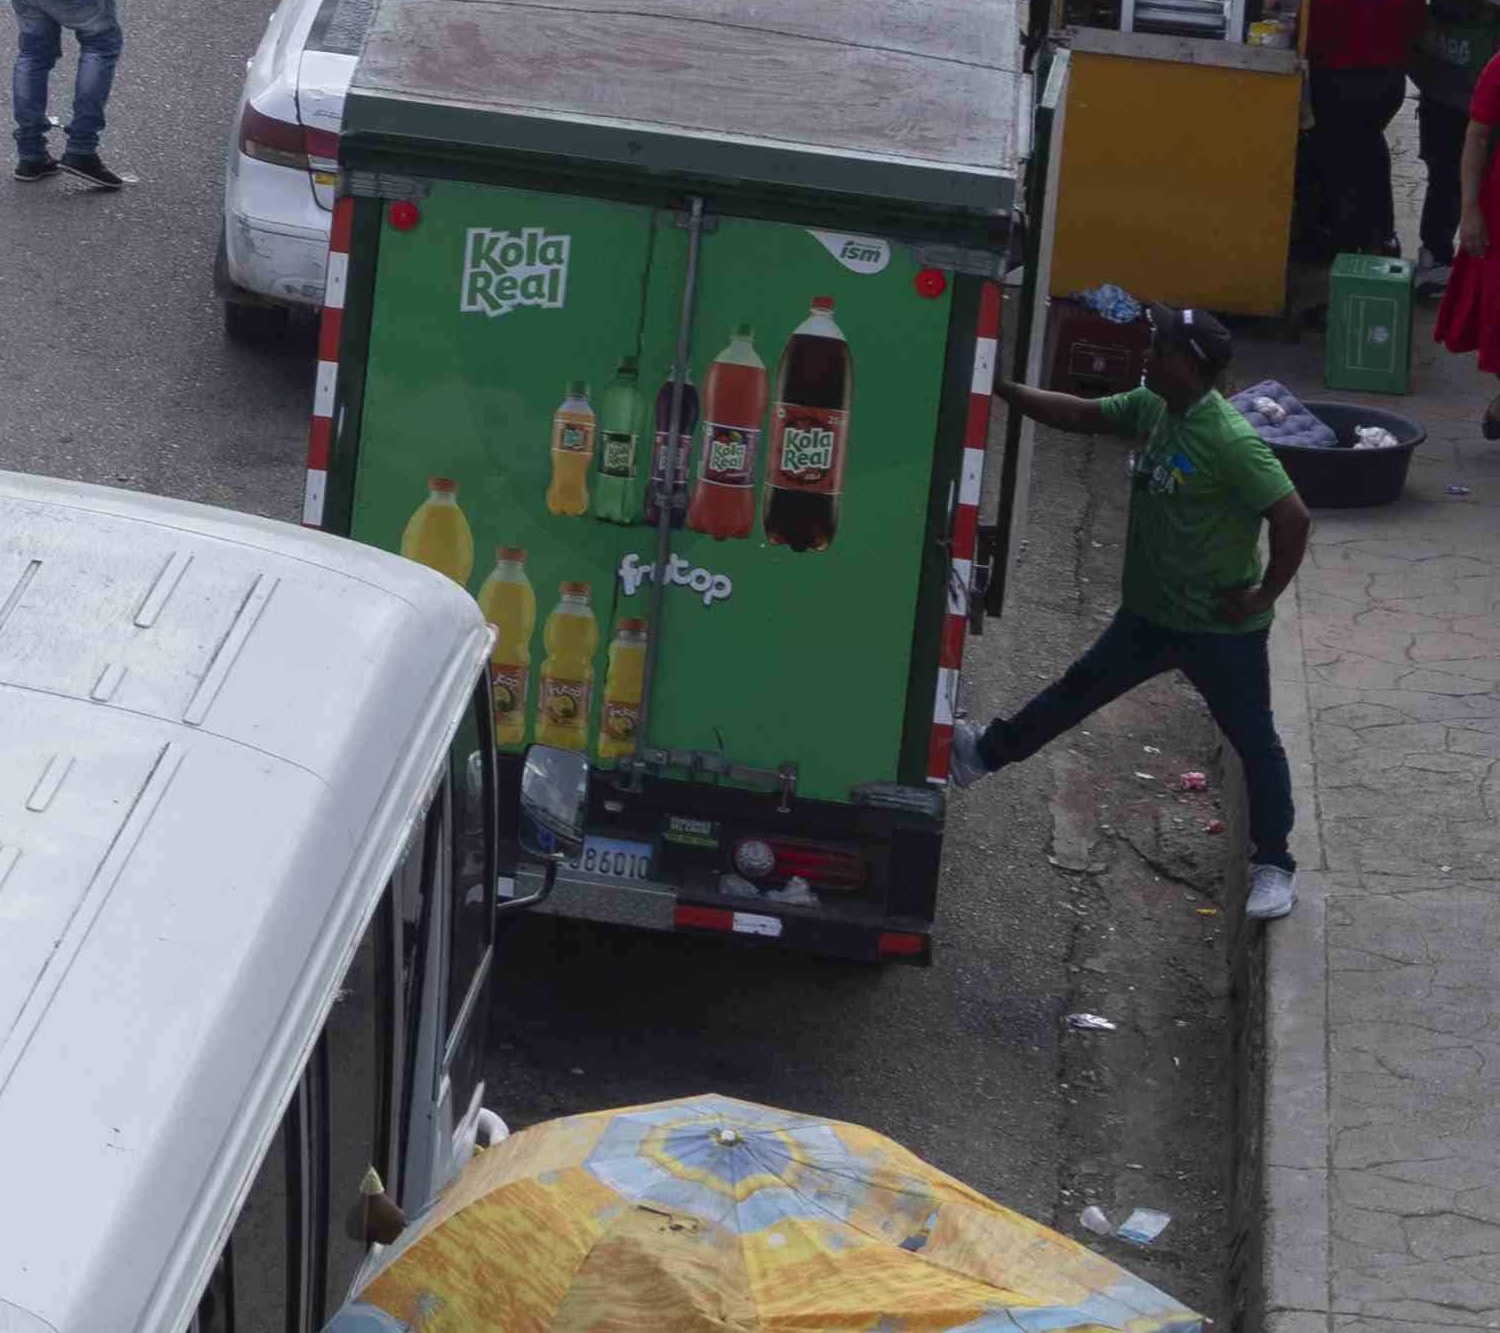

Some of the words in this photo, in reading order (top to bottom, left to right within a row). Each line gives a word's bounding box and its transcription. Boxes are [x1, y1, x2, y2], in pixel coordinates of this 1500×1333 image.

[471, 231, 565, 276] Kola
[840, 240, 882, 264] ism
[467, 267, 561, 317] Real
[787, 429, 832, 449] Kola
[783, 447, 831, 470] Real
